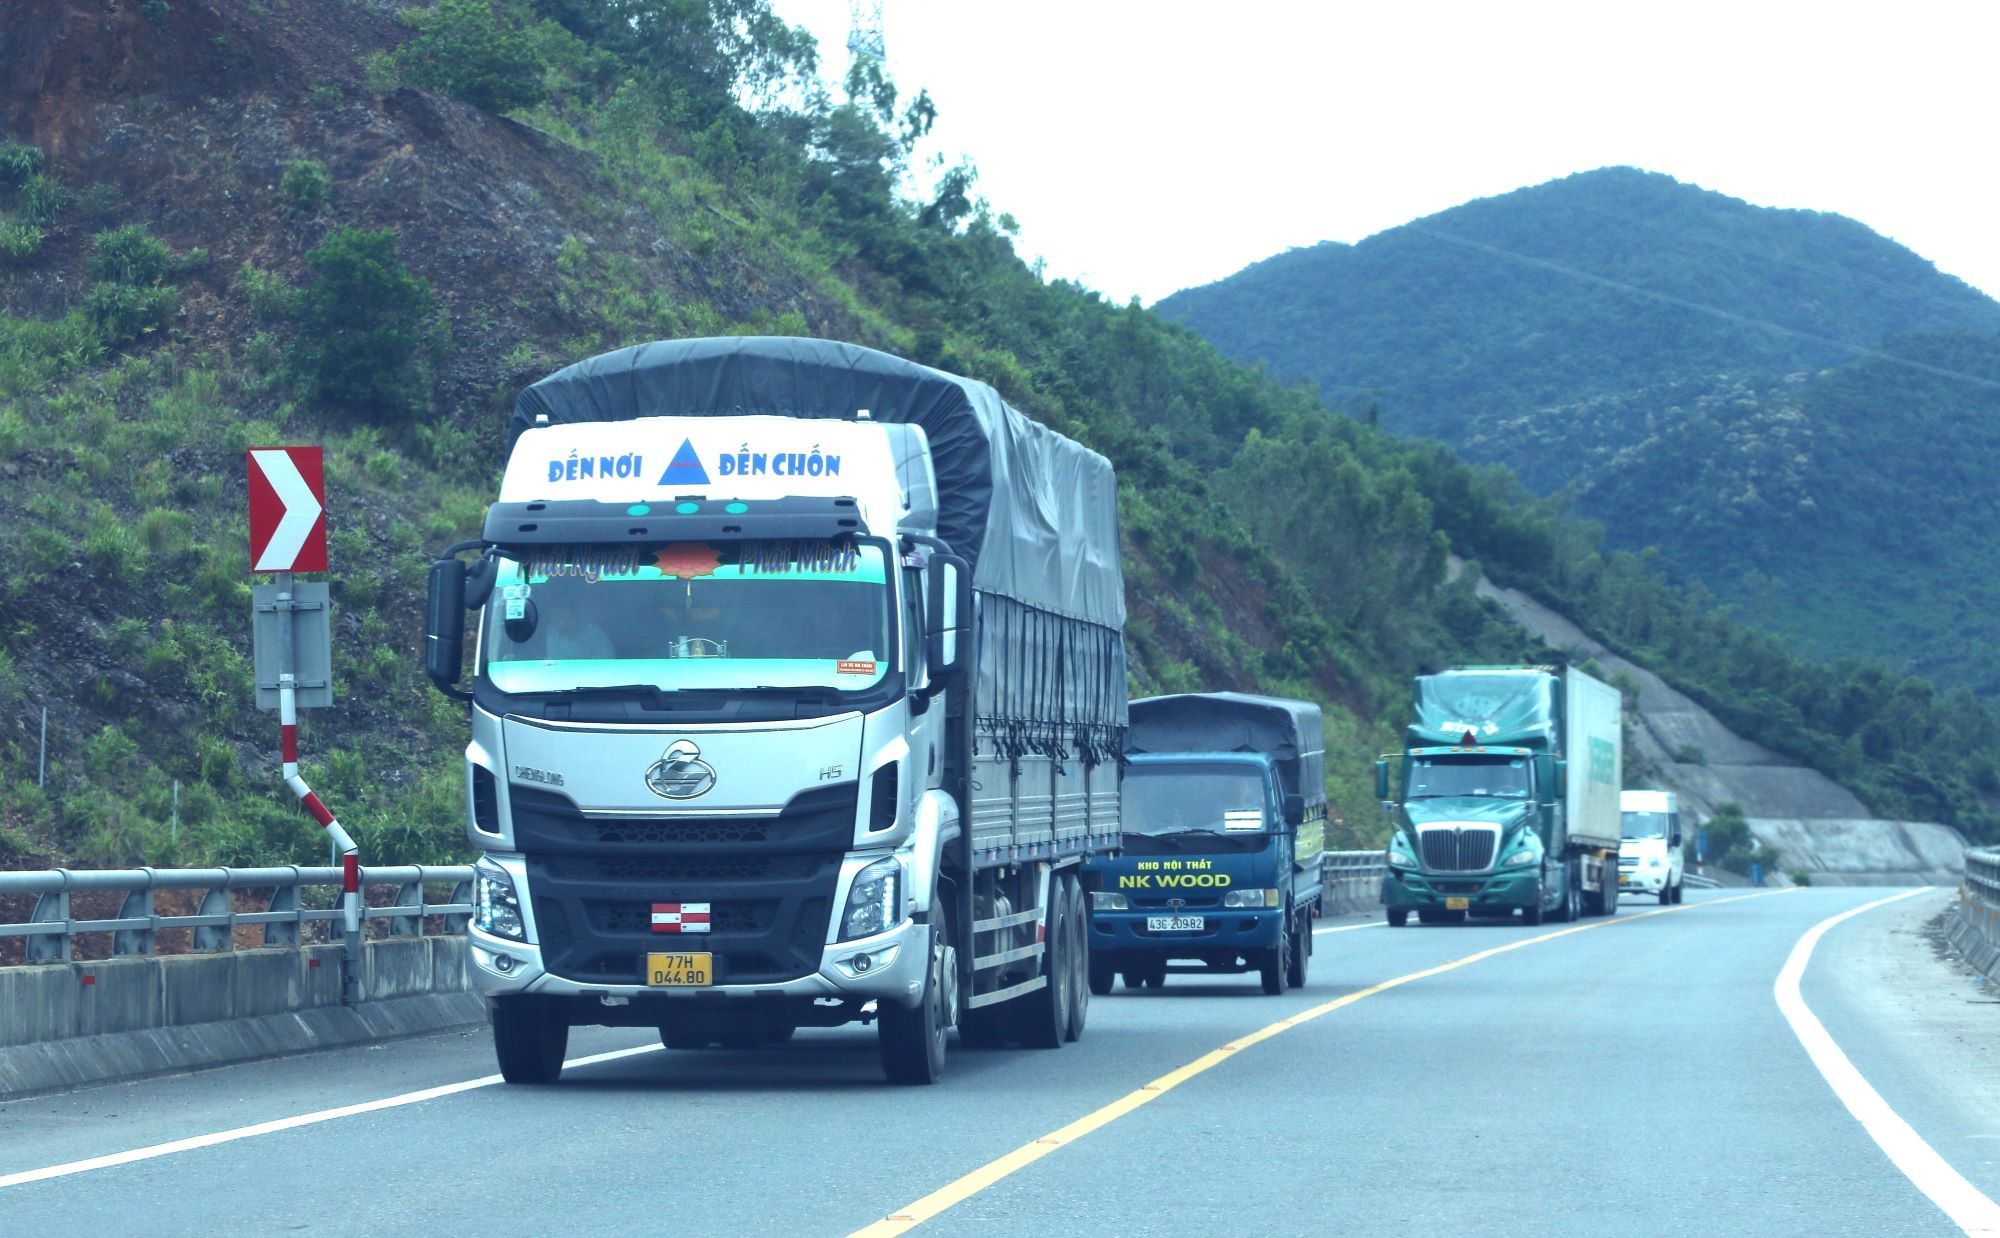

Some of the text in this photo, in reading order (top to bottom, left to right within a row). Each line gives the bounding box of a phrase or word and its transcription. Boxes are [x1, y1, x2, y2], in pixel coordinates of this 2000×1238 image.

[547, 448, 642, 482] ĐẾN NƠI
[718, 442, 840, 477] ĐẾN CHỐN
[515, 765, 564, 787] CHENGLONG
[819, 764, 842, 780] H5
[1138, 862, 1159, 870] KHO
[1119, 874, 1231, 888] NK WOOD
[666, 955, 693, 969] 77H
[654, 970, 705, 984] 044.80
